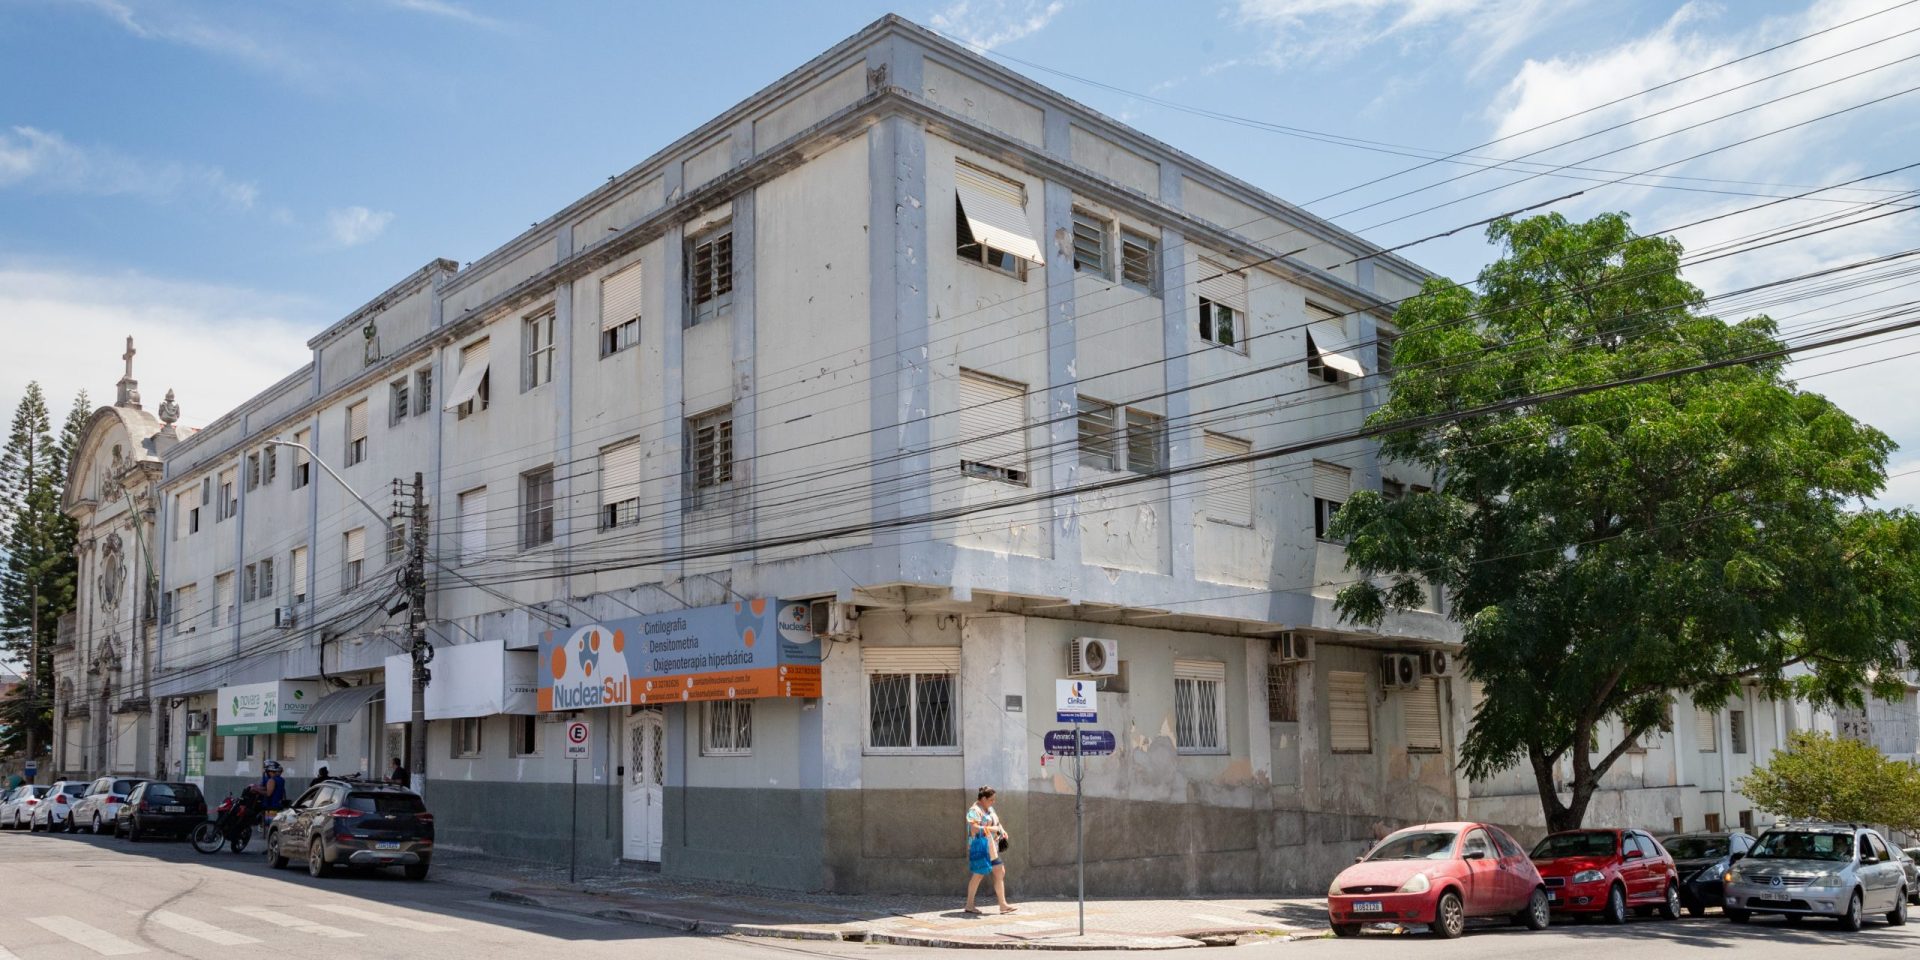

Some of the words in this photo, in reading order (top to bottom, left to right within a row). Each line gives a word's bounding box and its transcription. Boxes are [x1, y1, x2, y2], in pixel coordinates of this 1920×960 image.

[644, 618, 687, 636] Cintilografia
[779, 622, 811, 632] NuclearS
[649, 635, 699, 653] Densitometria
[653, 654, 707, 674] Oxigenoterapia
[709, 649, 754, 669] hiperbárica
[554, 674, 628, 709] NuclearSul
[263, 699, 277, 717] 24h
[574, 727, 582, 739] E
